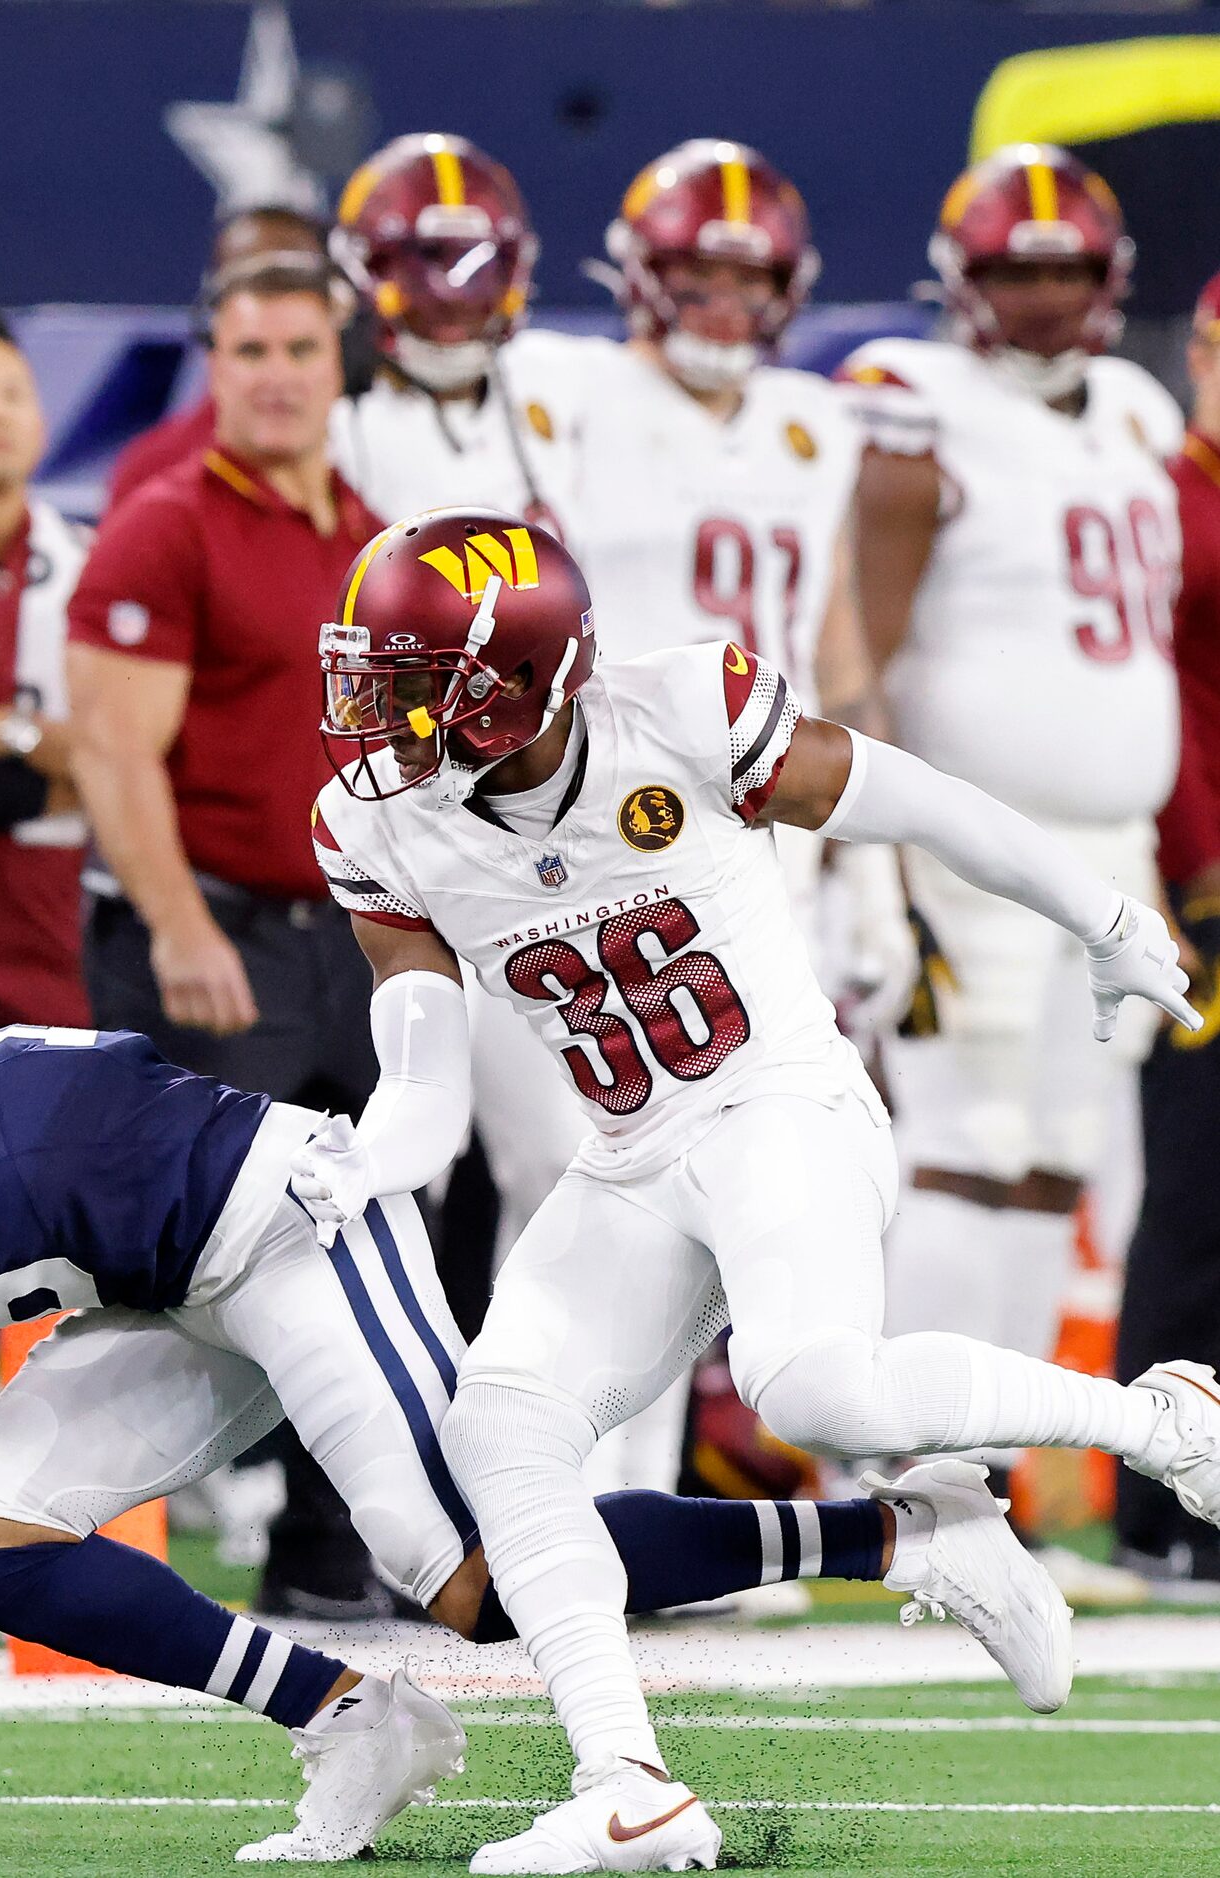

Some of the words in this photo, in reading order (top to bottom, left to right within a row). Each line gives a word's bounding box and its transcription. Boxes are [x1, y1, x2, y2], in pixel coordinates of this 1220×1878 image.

[384, 643, 423, 651] OAKLEY
[492, 884, 671, 949] WASHINGTON
[504, 897, 751, 1116] 36
